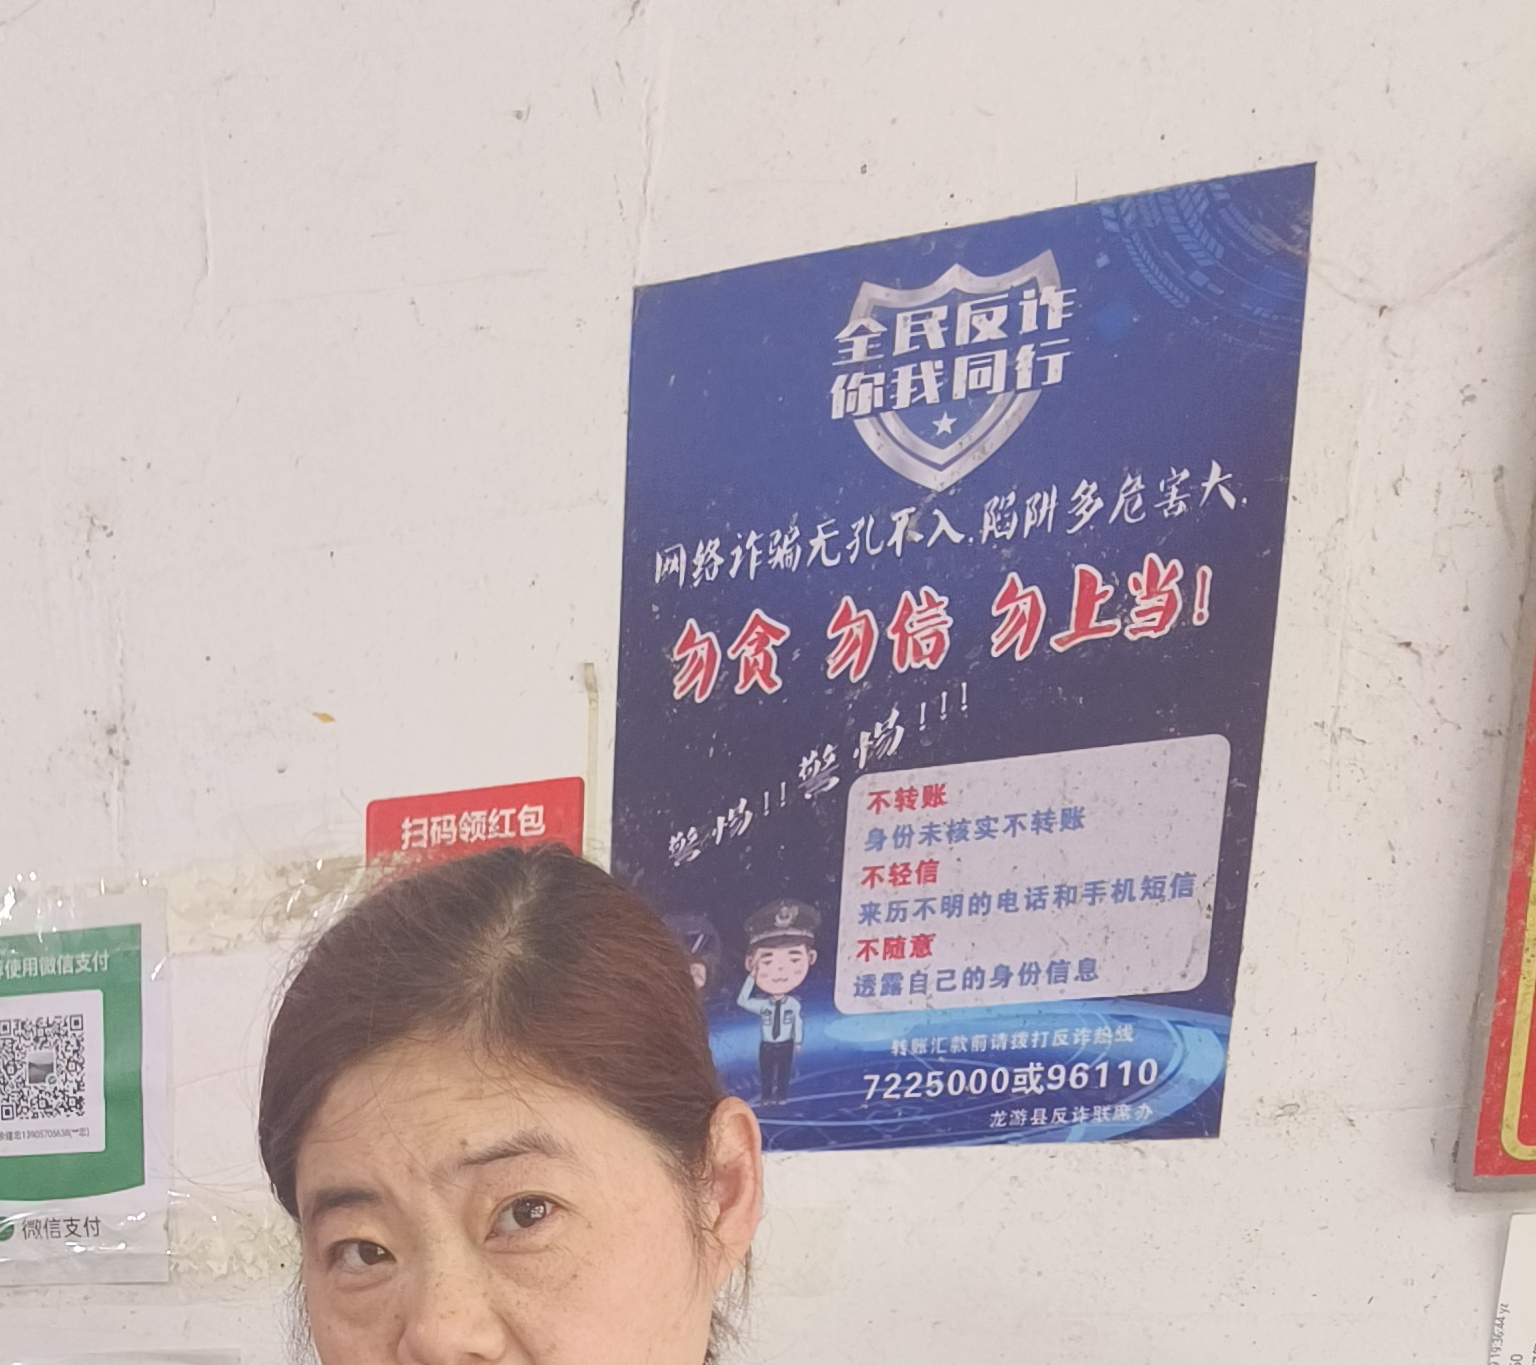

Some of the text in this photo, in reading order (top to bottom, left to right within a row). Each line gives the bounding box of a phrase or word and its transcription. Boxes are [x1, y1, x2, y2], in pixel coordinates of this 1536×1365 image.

[831, 286, 1077, 367] 全民反诈
[830, 338, 1071, 420] 你我同行
[670, 607, 792, 702] 勿贪
[825, 585, 954, 684] 勿信
[866, 783, 949, 816] 不转账
[400, 804, 547, 851] 扫码领红包
[864, 806, 1088, 854] 身份未核实不转账
[860, 858, 941, 890] 不轻信
[856, 871, 1198, 928] 来历不明的电话和手机短信
[854, 932, 938, 964] 不随意
[852, 957, 1101, 1000] 透露自己的身份信息
[889, 1023, 1136, 1057] 转账汇款前请拨打反诈热线
[862, 1057, 1159, 1101] 7225000或96110
[21, 1216, 101, 1241] 微信支付
